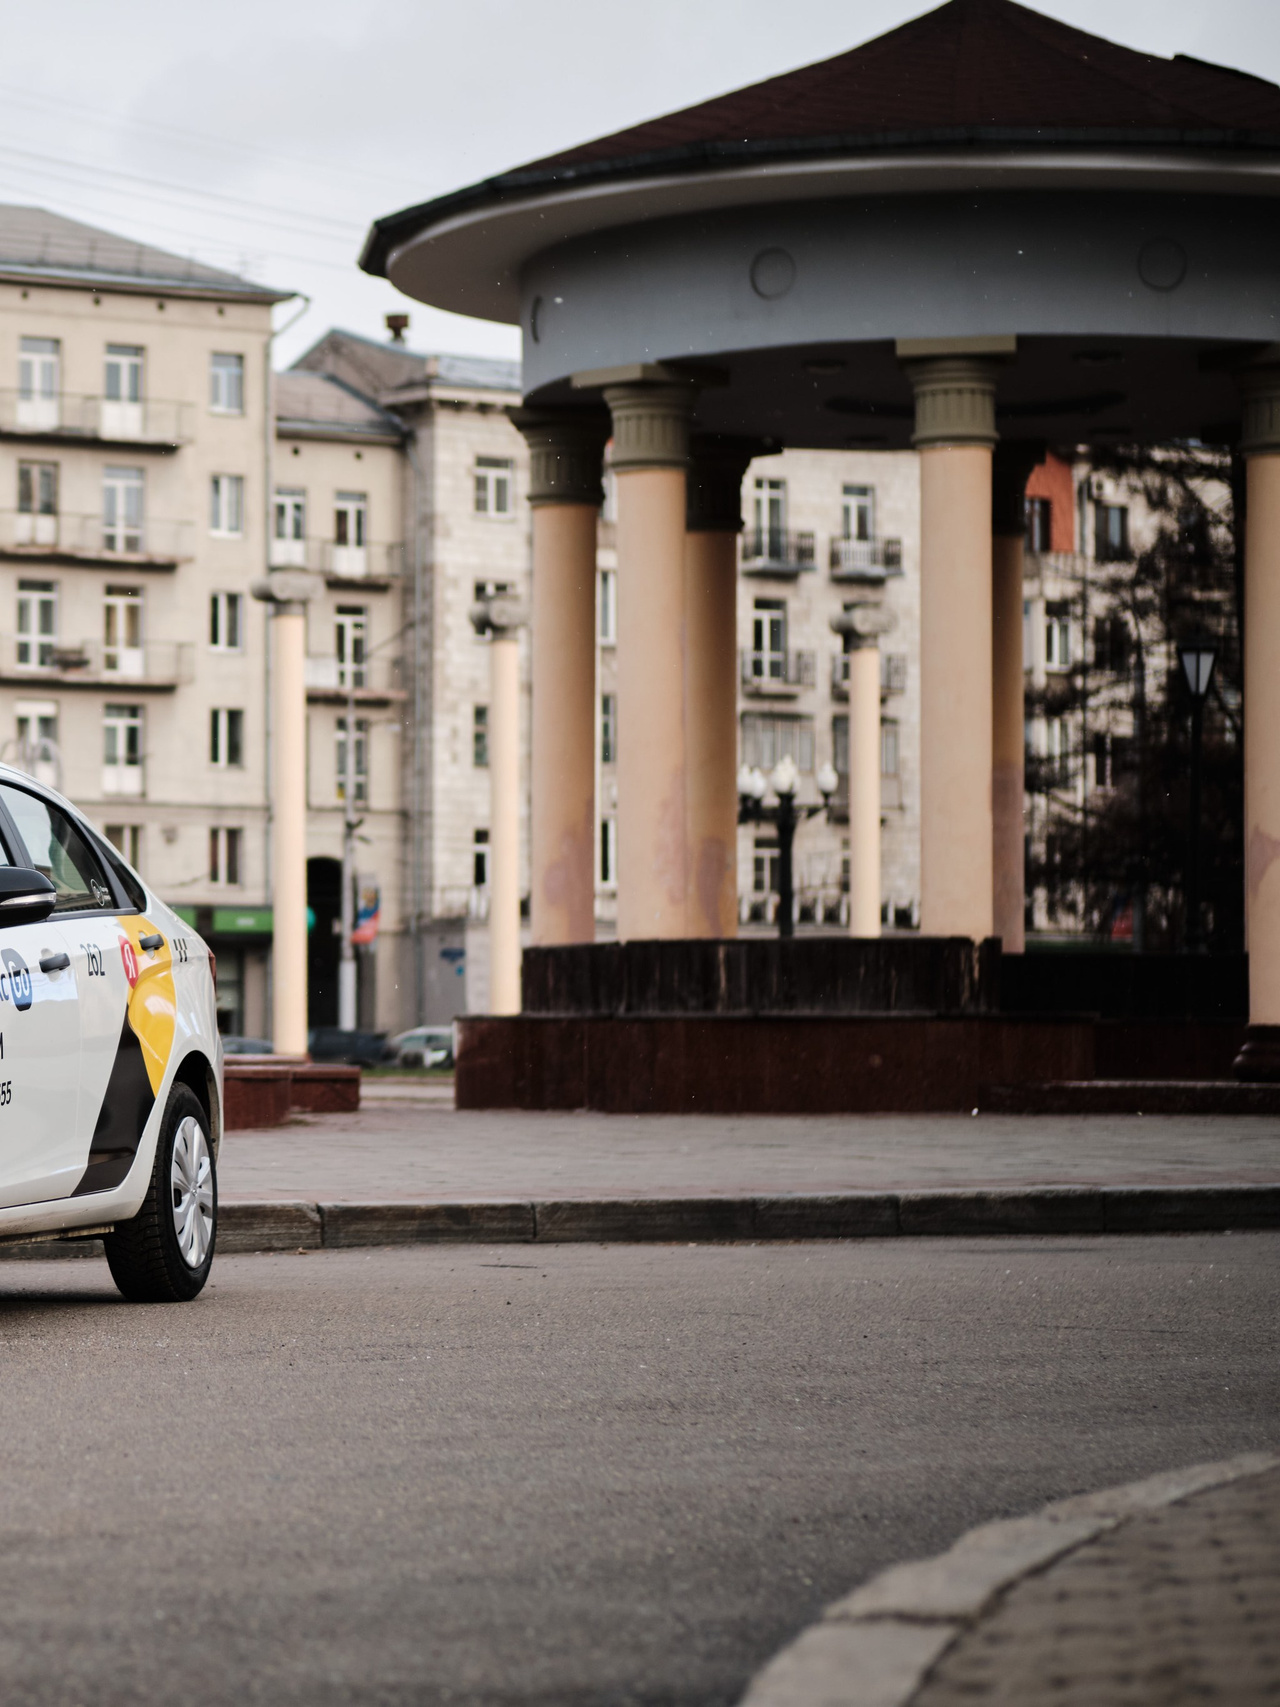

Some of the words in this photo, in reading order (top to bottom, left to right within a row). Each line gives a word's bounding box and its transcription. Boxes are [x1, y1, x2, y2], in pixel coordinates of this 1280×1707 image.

[80, 943, 105, 977] 262
[124, 943, 136, 979] Я
[8, 960, 30, 998] Go
